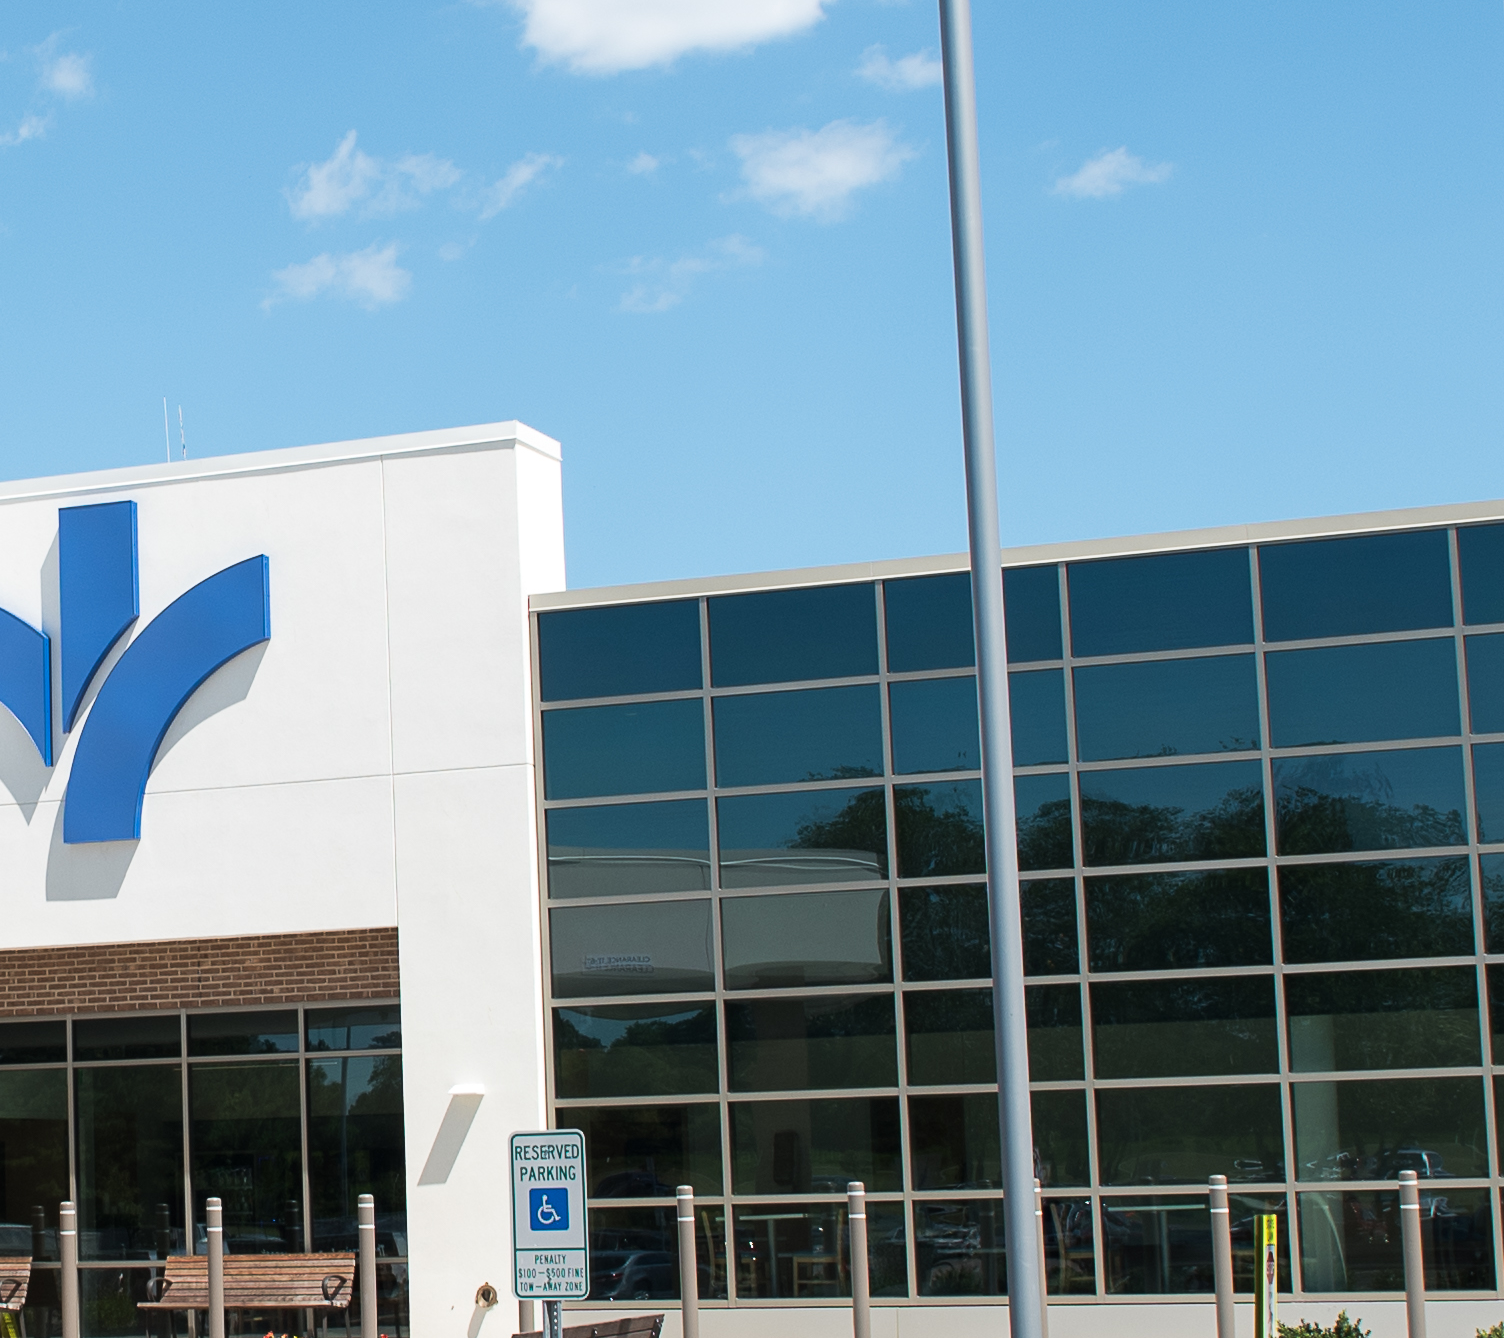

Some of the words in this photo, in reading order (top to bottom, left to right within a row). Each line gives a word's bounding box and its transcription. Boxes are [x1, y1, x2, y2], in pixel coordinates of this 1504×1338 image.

[515, 1144, 579, 1160] RESERVED
[520, 1164, 576, 1181] PARKING
[535, 1254, 566, 1264] PENALTY
[568, 1267, 584, 1278] FINE
[565, 1281, 583, 1292] ZONE
